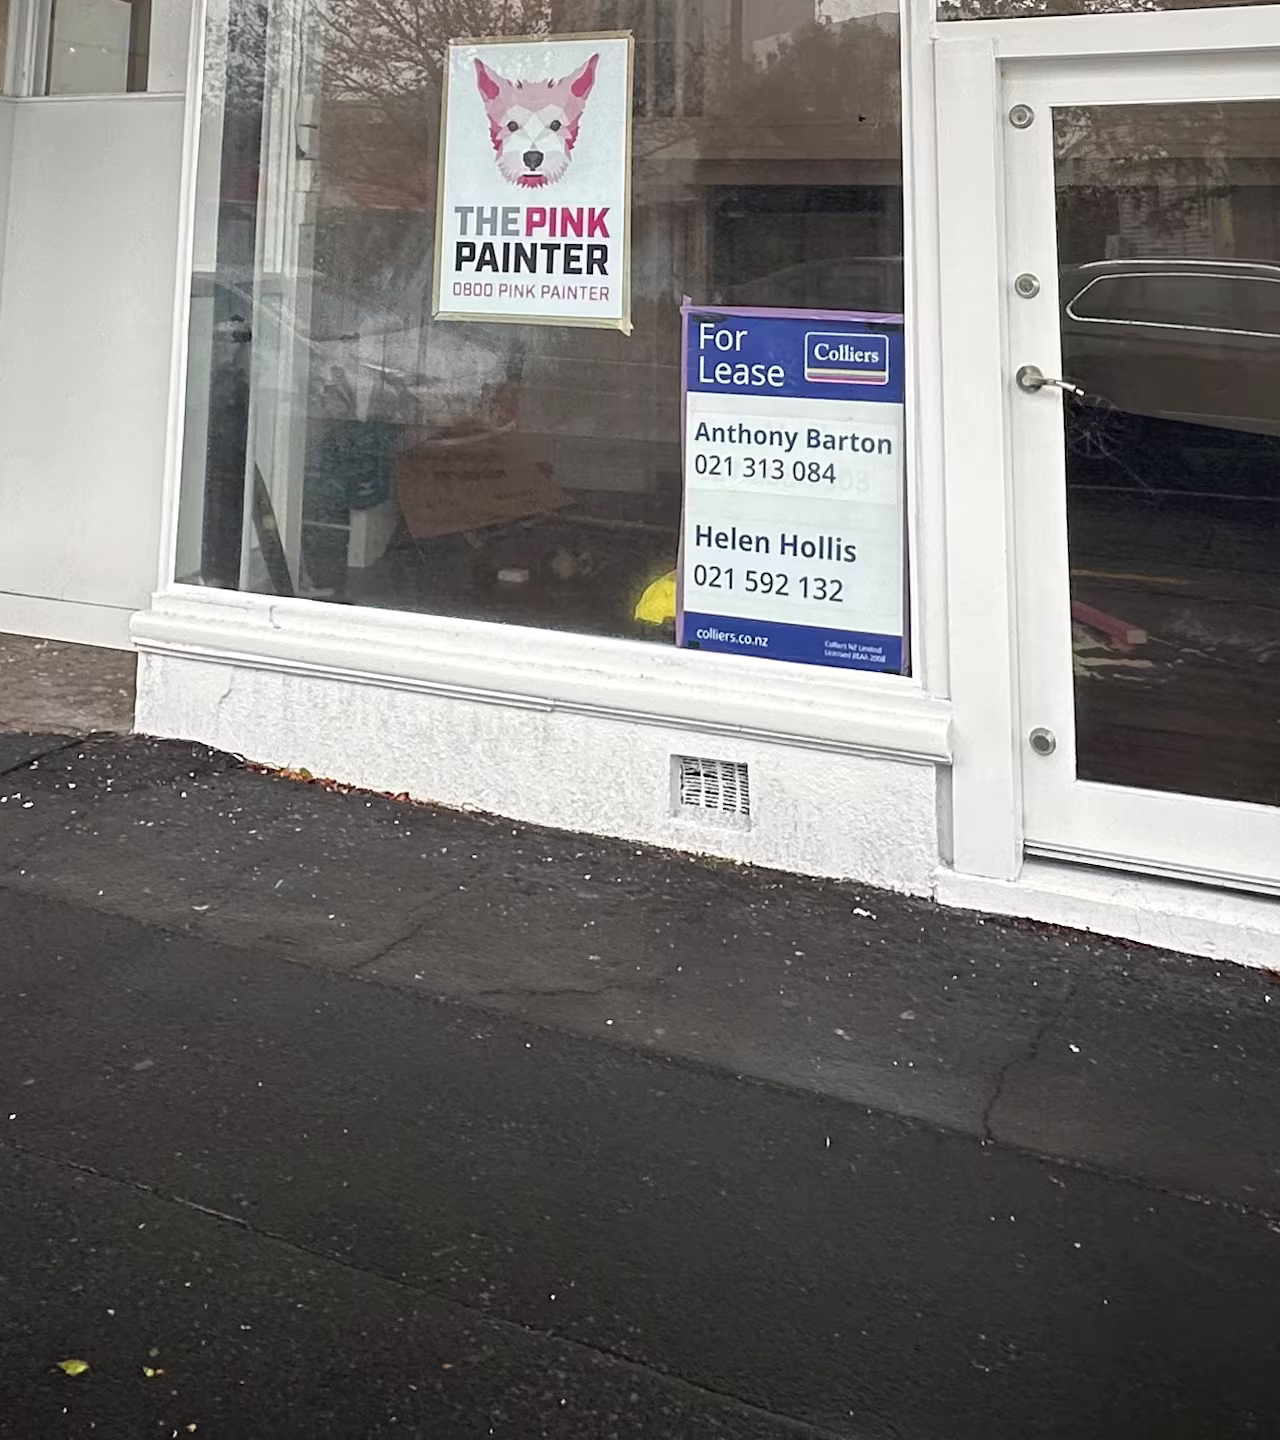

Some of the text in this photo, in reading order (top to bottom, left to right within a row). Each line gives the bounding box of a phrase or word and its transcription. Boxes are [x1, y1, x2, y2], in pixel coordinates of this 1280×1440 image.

[454, 206, 611, 238] THE PINK
[454, 241, 610, 276] PAINTER
[453, 281, 610, 301] 0800 PINK PAINTER
[699, 323, 748, 352] For
[813, 343, 880, 364] Colliers
[699, 355, 785, 387] Lease
[694, 422, 892, 455] Anthony Barton
[694, 454, 733, 477] 021
[742, 457, 785, 480] 313
[792, 460, 837, 484] 084
[695, 524, 857, 563] Helen Hollis
[694, 564, 844, 602] 021 592 132
[696, 627, 769, 647] colliers.co.nz
